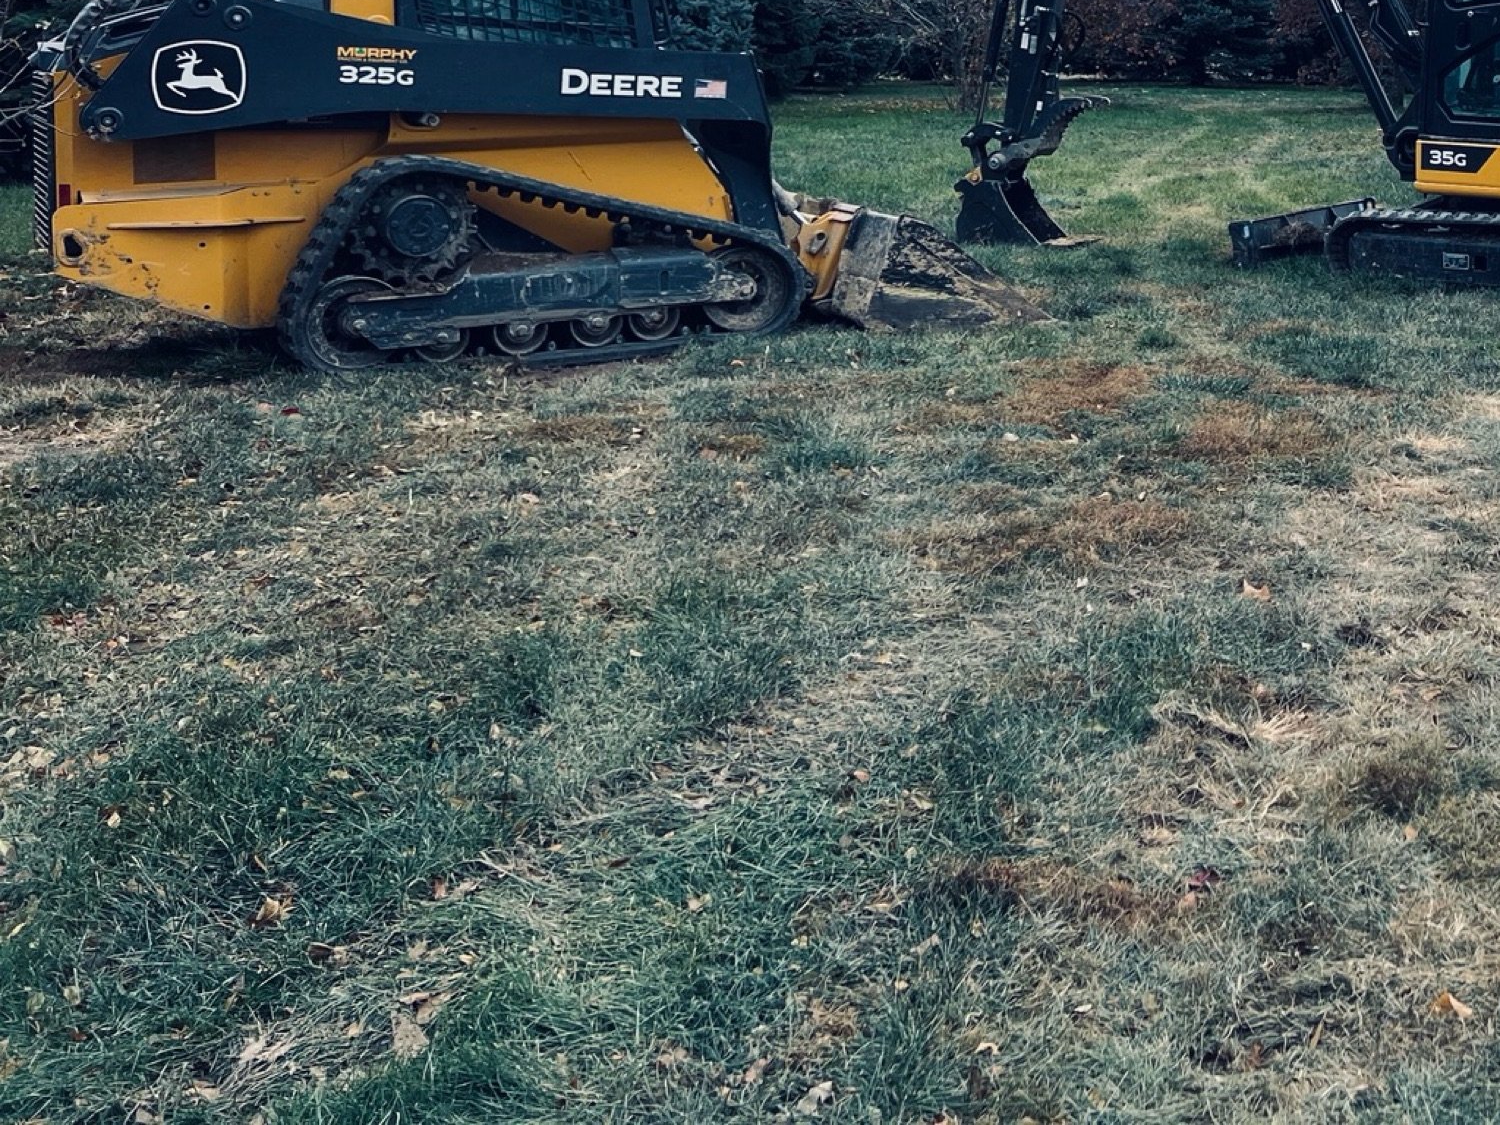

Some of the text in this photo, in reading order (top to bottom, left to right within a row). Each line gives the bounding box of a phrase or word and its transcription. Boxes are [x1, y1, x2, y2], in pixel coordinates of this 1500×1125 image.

[337, 46, 418, 60] MURPHY
[338, 65, 415, 86] 325G
[560, 68, 683, 98] DEERE
[1428, 149, 1467, 167] 35G
